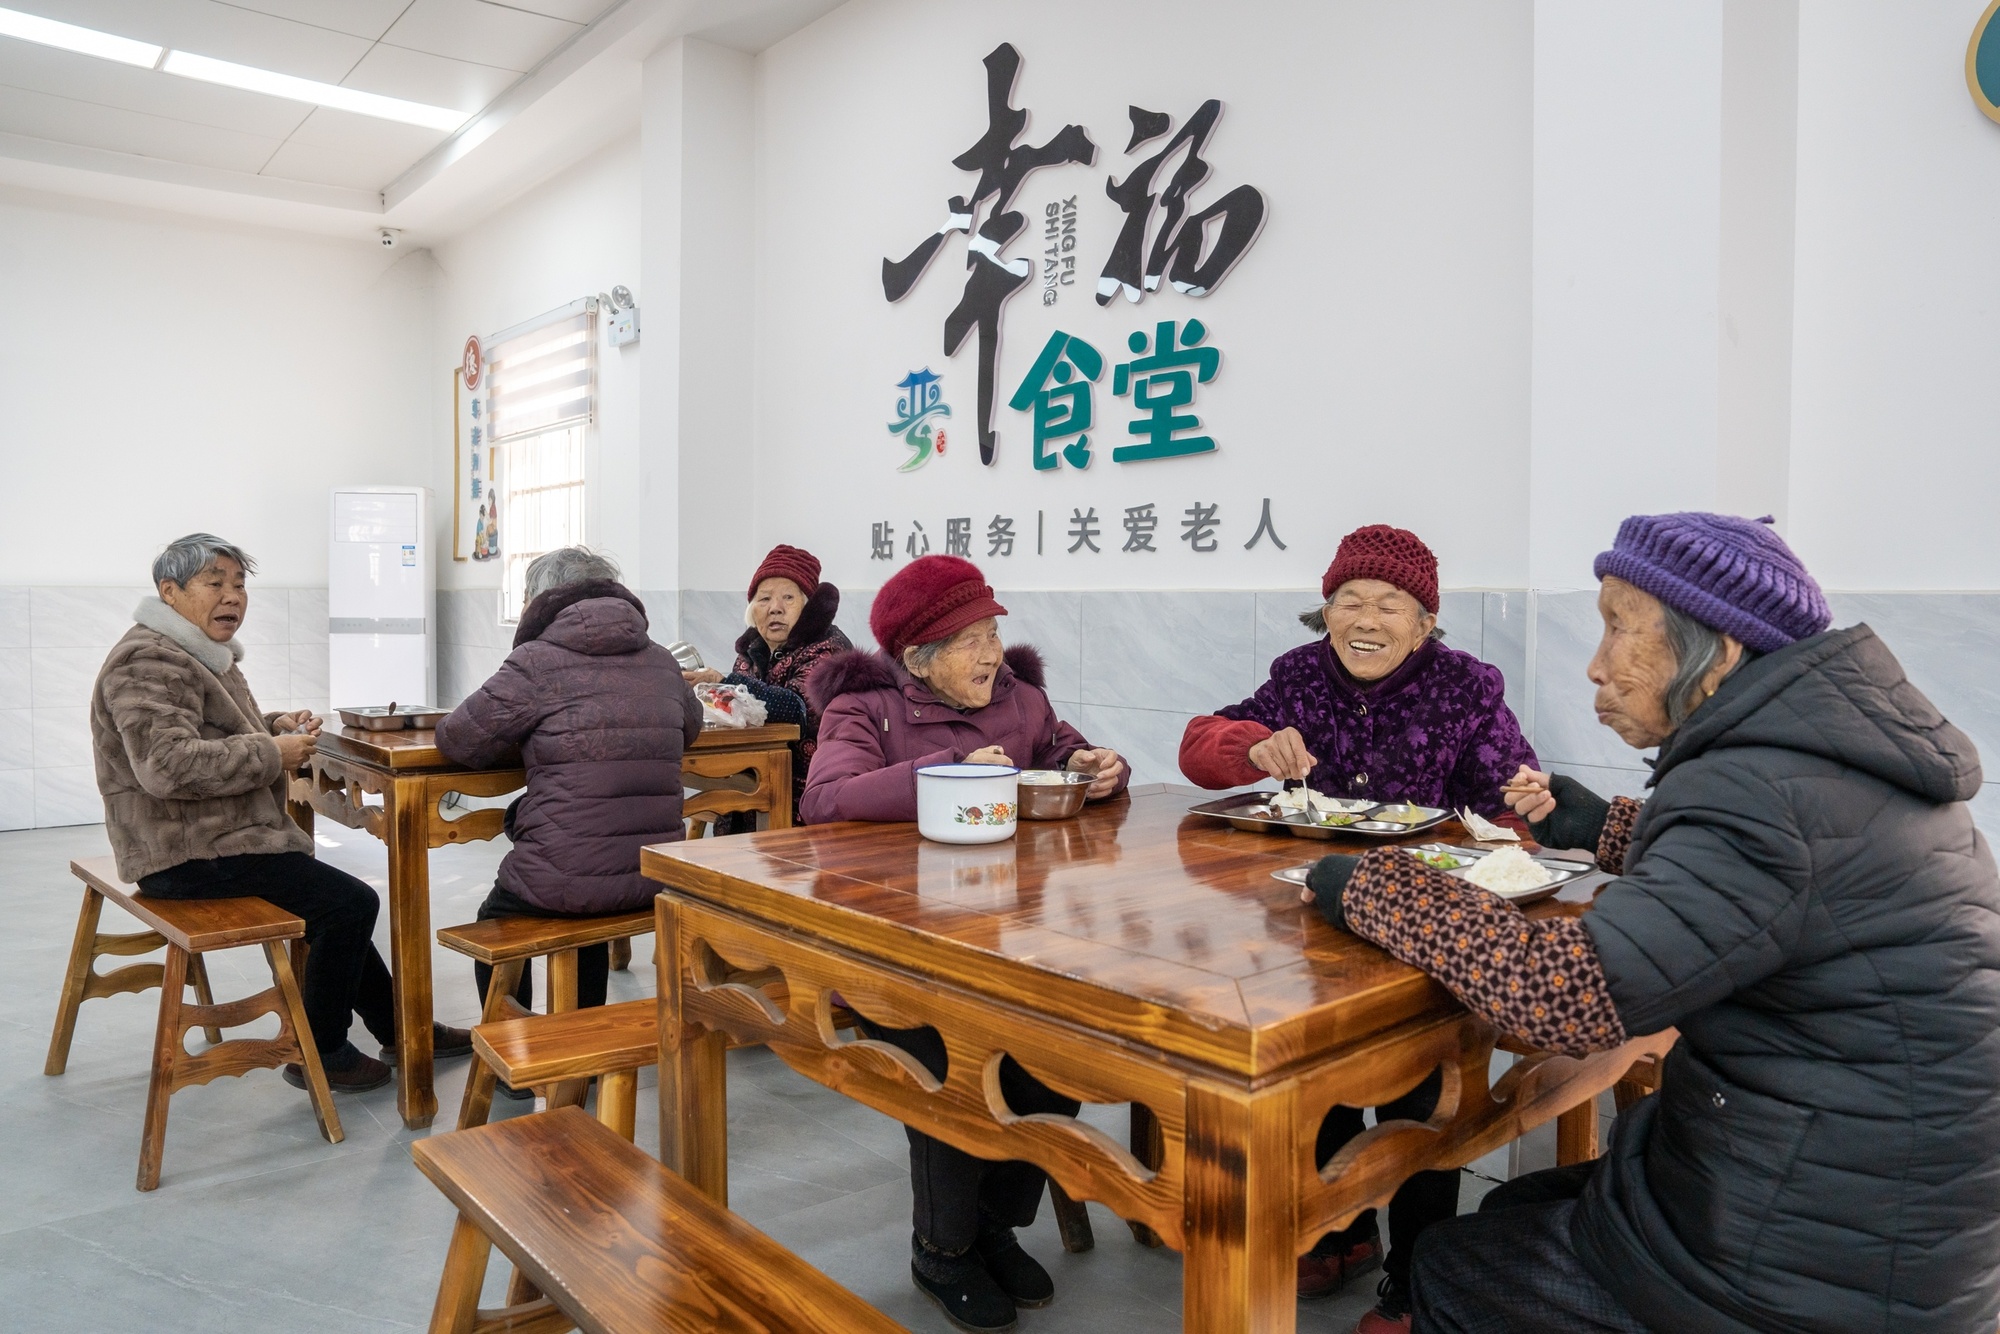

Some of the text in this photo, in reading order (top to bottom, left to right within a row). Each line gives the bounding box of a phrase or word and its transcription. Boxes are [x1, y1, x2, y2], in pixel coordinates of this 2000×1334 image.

[882, 42, 1270, 466] 幸福
[1043, 202, 1060, 307] SHI TANG
[1060, 194, 1077, 286] XING FU
[1008, 318, 1222, 471] 食堂
[870, 497, 1288, 561] 贴心服务 关爱老人
